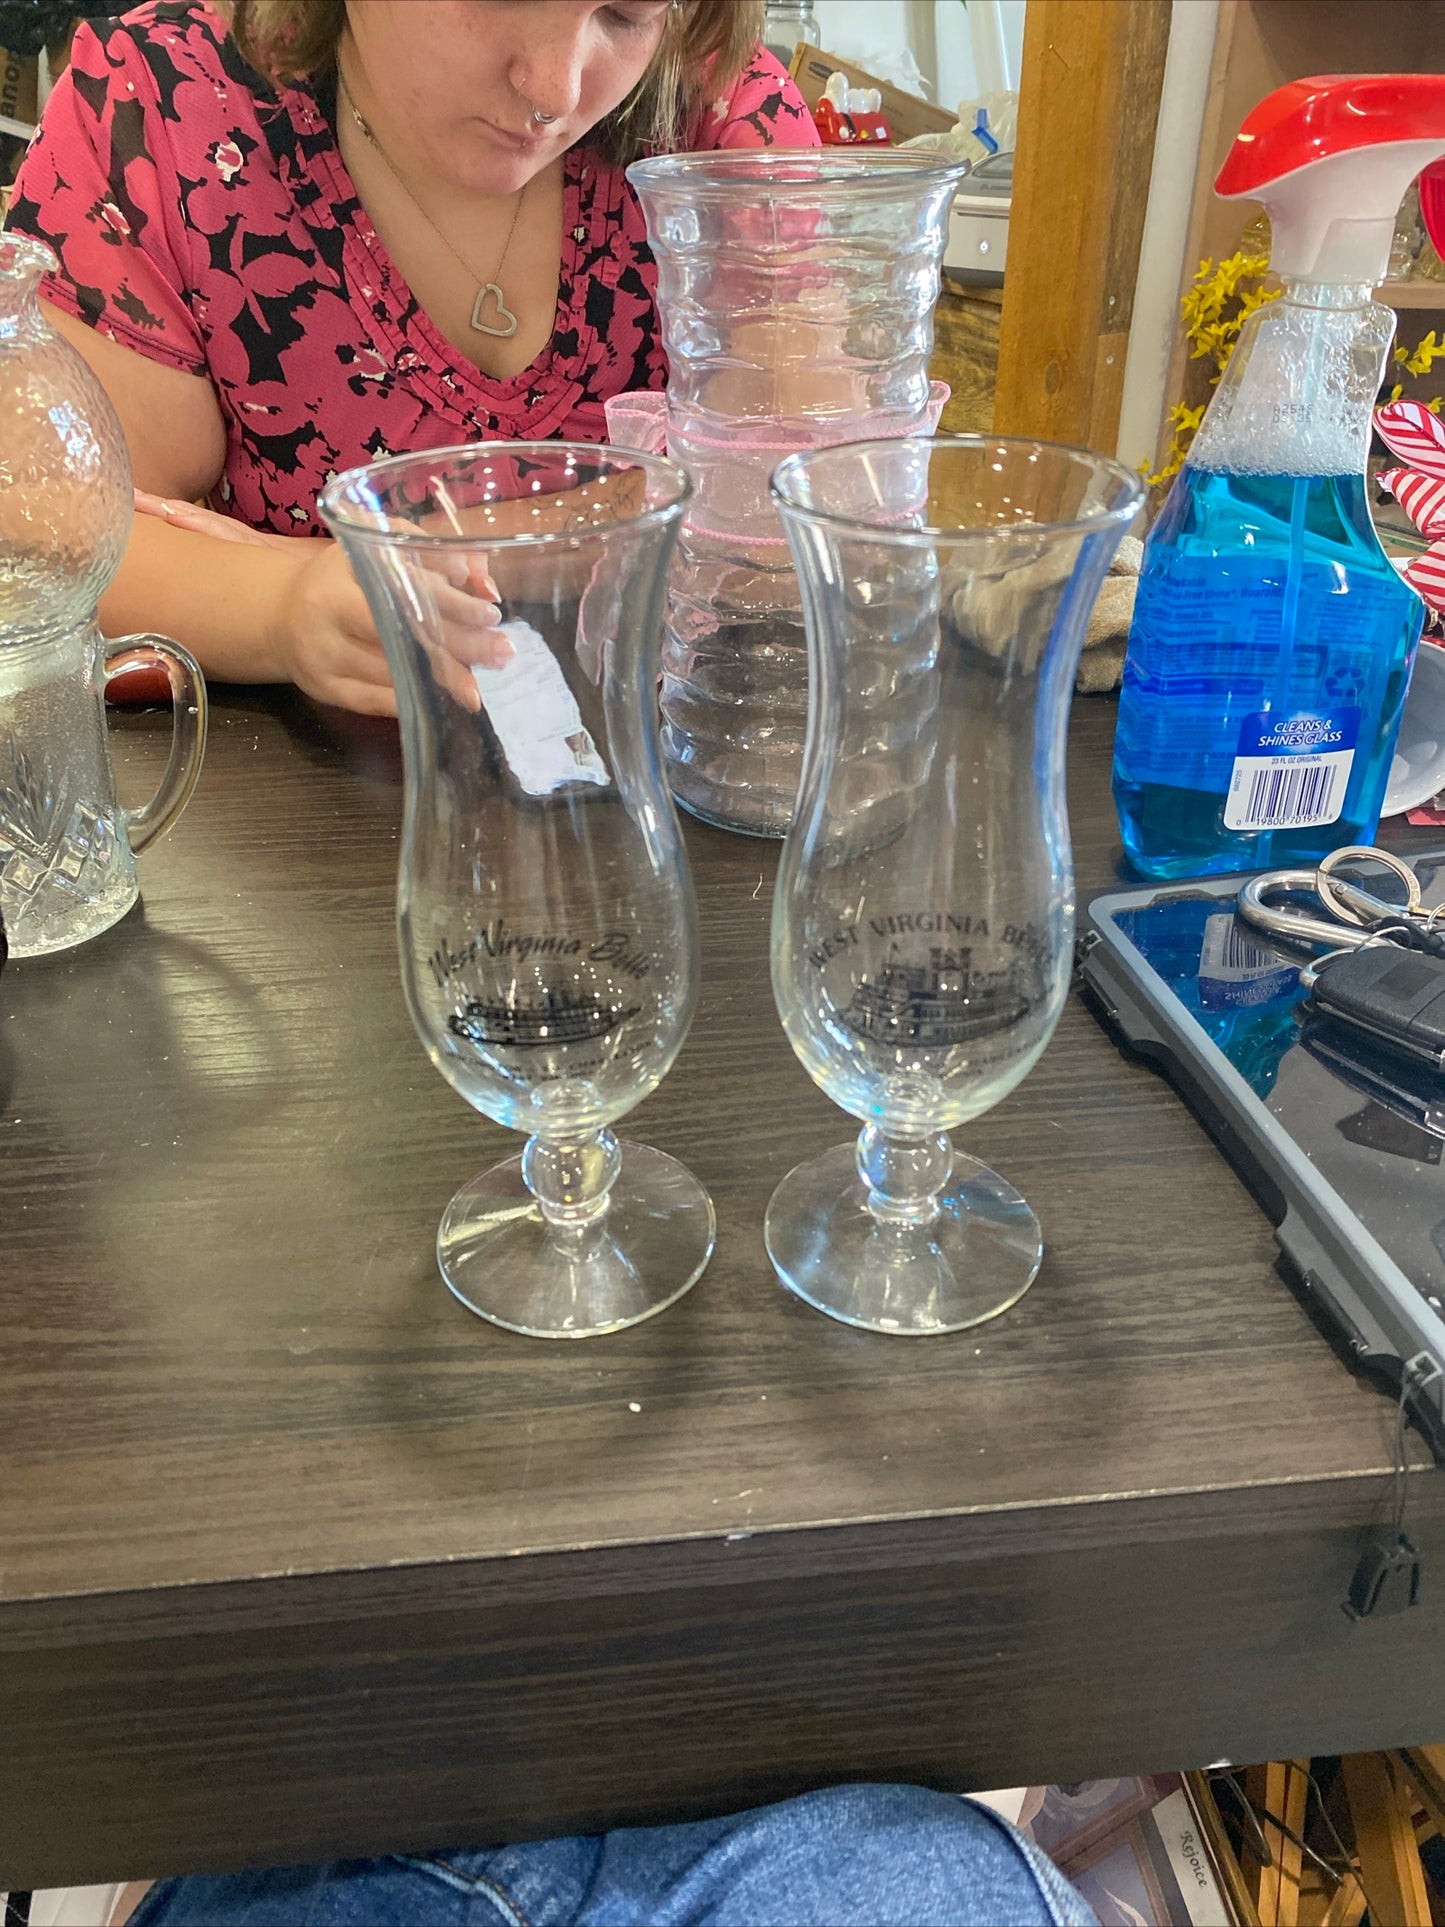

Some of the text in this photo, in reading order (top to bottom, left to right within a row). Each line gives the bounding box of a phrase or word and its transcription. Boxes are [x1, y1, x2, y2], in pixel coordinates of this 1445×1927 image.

[1274, 719, 1332, 733] CLEANS &
[1258, 731, 1343, 747] SHINES GLASS
[1271, 755, 1323, 765] 23 FL OZ ORIGINAL
[1256, 817, 1286, 827] 19800
[1289, 815, 1318, 825] 70195
[808, 924, 861, 969] WEST
[870, 912, 990, 938] VIRGINIA
[428, 938, 476, 988] West
[481, 919, 582, 963] Virginia
[1179, 1830, 1208, 1888] Rejoice
